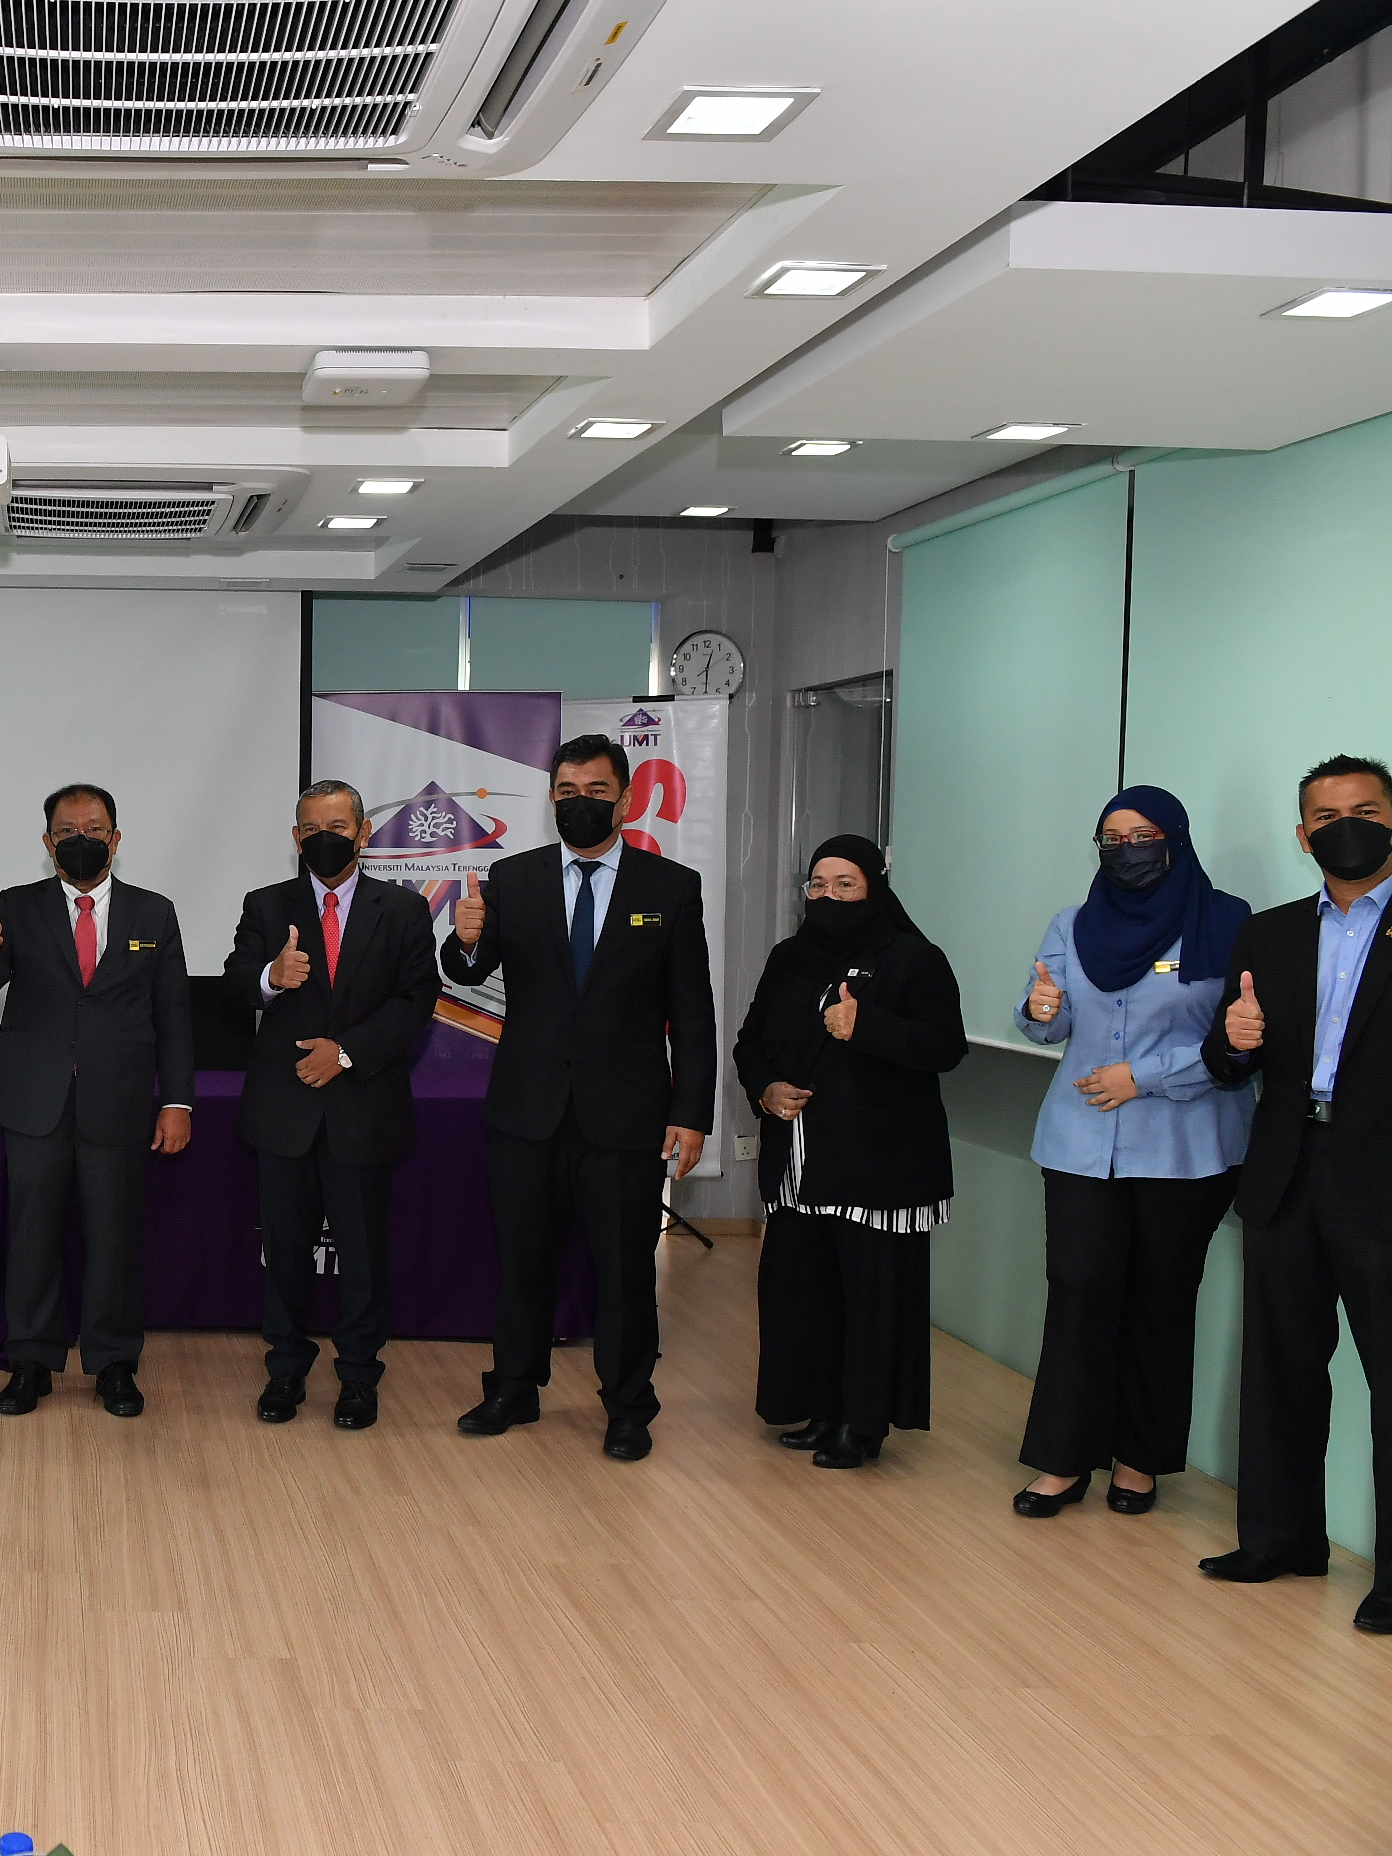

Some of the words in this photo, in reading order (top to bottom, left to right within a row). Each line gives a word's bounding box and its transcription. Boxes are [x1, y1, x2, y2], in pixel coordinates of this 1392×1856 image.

[702, 640, 711, 648] 12
[717, 643, 721, 651] 1
[682, 652, 691, 661] 10
[726, 652, 731, 661] 2
[678, 665, 684, 673] 9
[729, 666, 734, 674] 3
[681, 678, 687, 686] 8
[724, 679, 730, 687] 4
[620, 734, 661, 747] UMT
[358, 862, 403, 872] UNIVERSITI
[404, 862, 450, 872] MALAYSIA
[452, 862, 489, 872] TERENGG
